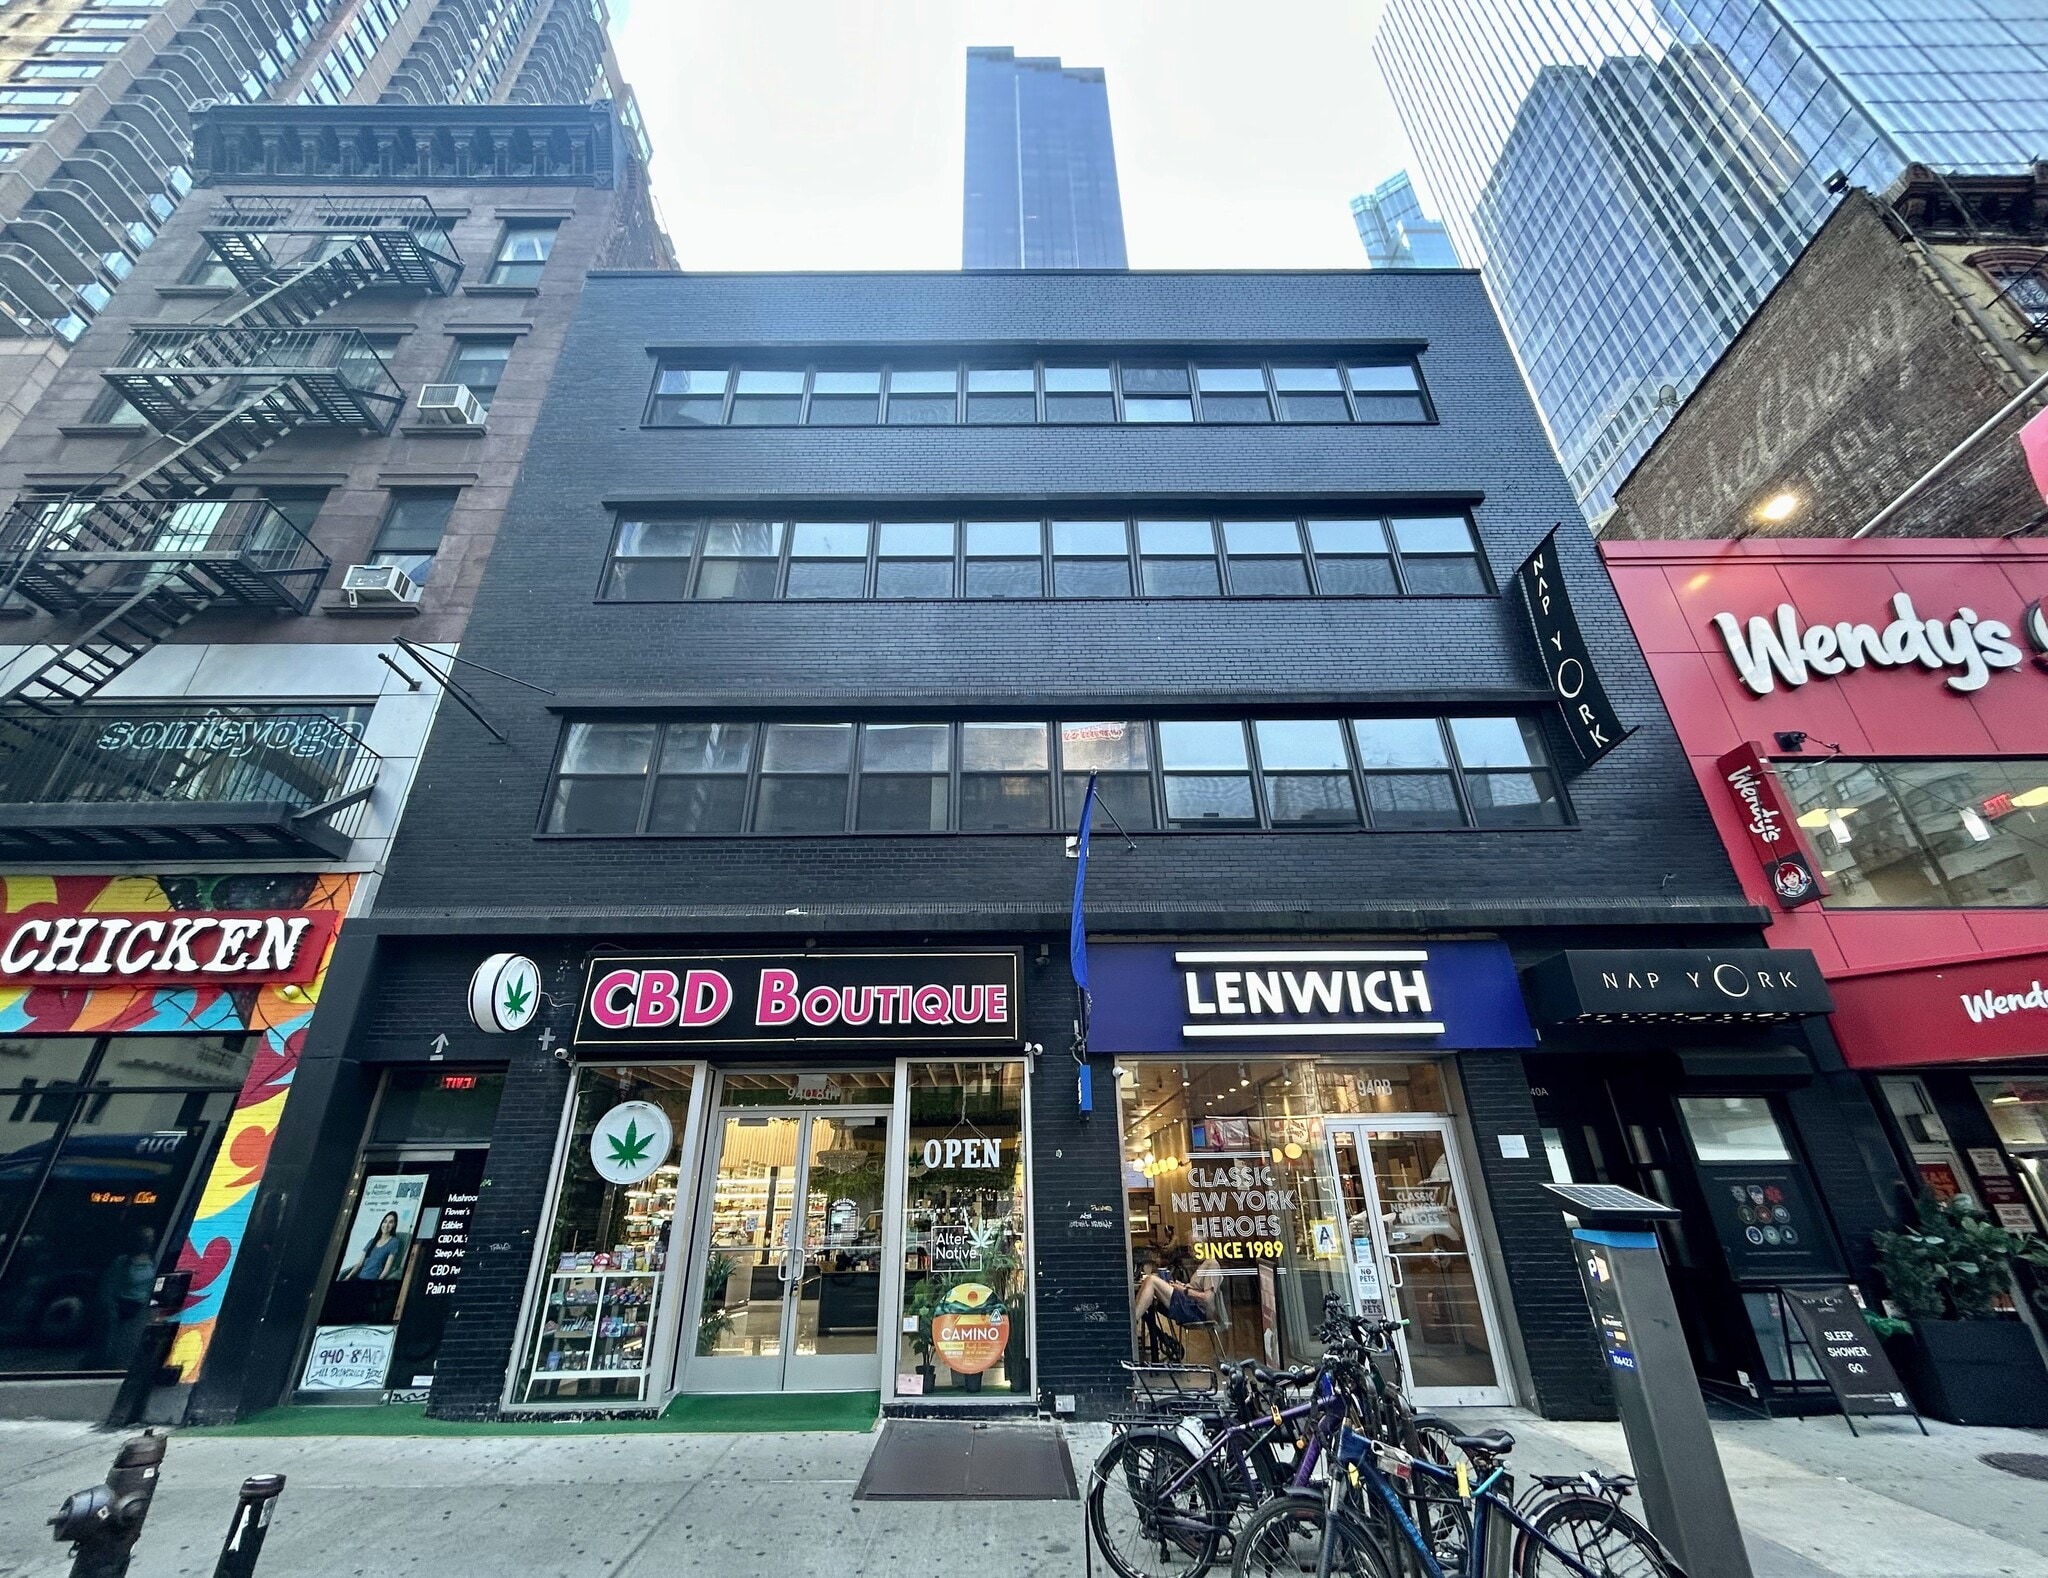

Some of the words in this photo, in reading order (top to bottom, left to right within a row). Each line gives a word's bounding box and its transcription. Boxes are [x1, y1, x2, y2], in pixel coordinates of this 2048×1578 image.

[1532, 553, 1551, 616] NAP
[1550, 630, 1610, 749] YORK
[1712, 592, 2023, 694] Wendy's
[1727, 765, 1781, 843] Wendy's
[0, 916, 313, 976] CHICKEN
[1602, 971, 1660, 990] NAP
[1686, 963, 1798, 998] YORK
[590, 968, 733, 1029] CBD
[755, 968, 1008, 1027] BOUTIQUE
[1185, 969, 1433, 1015] LENWICH
[923, 1138, 1002, 1169] OPEN
[1187, 1166, 1273, 1188] CLASSIC
[1171, 1191, 1228, 1213] NEW
[1231, 1190, 1297, 1212] YORK
[1396, 1191, 1436, 1202] CLASSIC
[441, 1220, 464, 1230] Edibles
[1191, 1214, 1281, 1238] HEROES
[437, 1234, 452, 1243] CBD
[935, 1232, 968, 1245] Alter
[434, 1248, 453, 1259] Sleep
[935, 1246, 977, 1260] Native
[1193, 1241, 1244, 1260] SINCE
[1245, 1240, 1284, 1259] 1989
[429, 1265, 450, 1276] CBD
[425, 1282, 446, 1295] Pain
[1362, 1305, 1382, 1314] PETS
[941, 1327, 999, 1341] CAMINO
